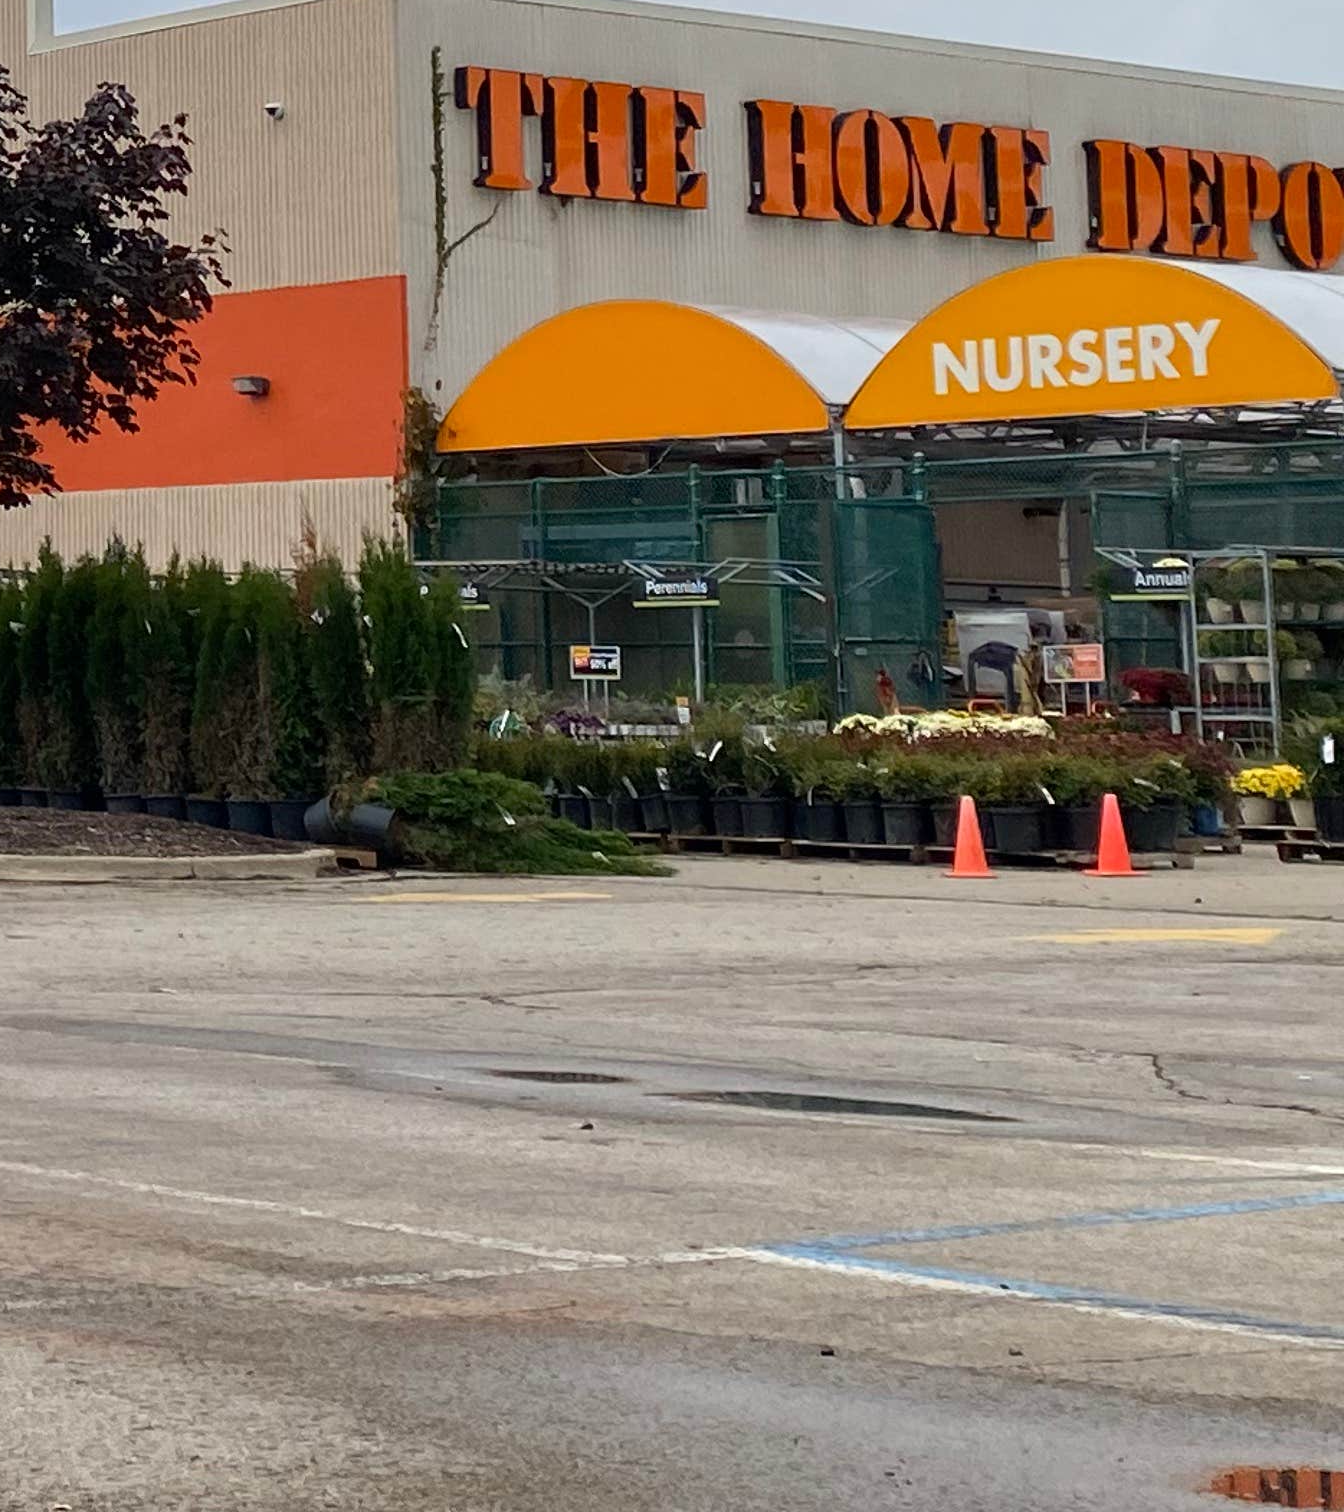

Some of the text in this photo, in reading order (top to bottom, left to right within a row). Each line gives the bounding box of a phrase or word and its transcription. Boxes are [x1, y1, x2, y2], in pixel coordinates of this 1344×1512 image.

[454, 65, 1344, 271] THE HOME DEPO
[932, 318, 1221, 395] NURSERY
[645, 576, 709, 595] Perennials
